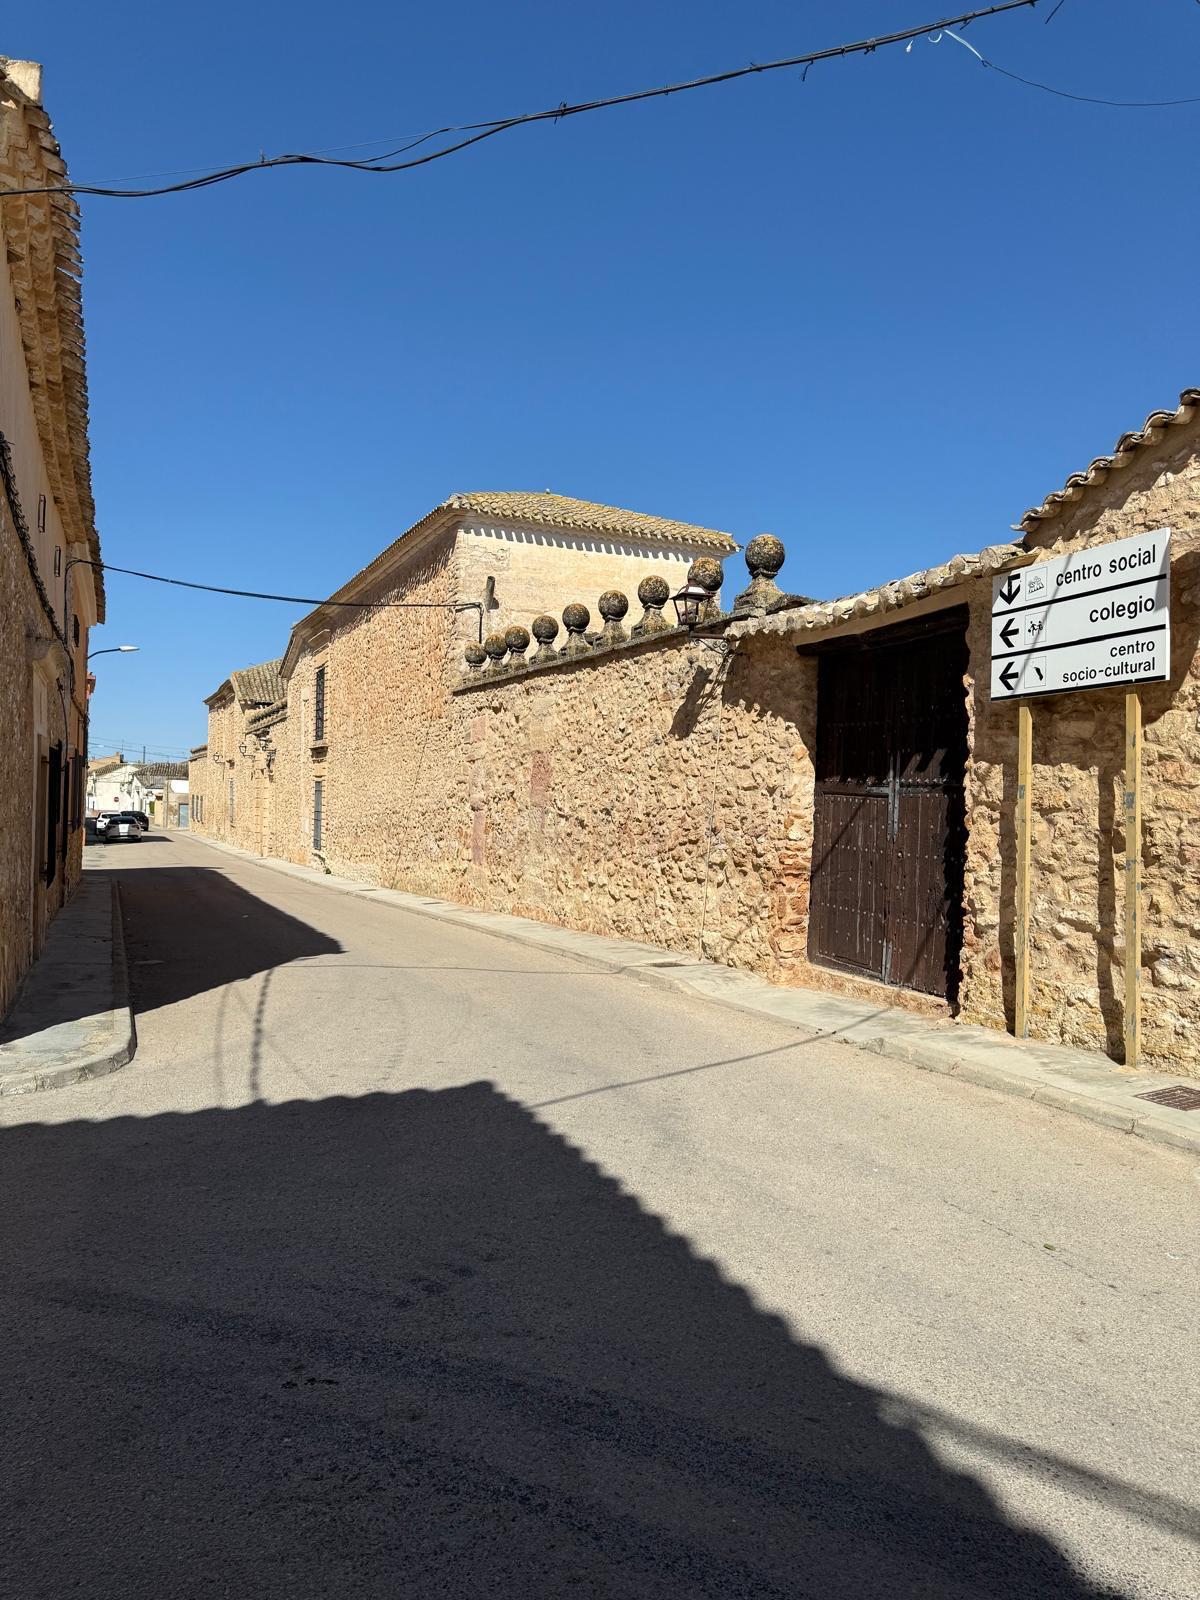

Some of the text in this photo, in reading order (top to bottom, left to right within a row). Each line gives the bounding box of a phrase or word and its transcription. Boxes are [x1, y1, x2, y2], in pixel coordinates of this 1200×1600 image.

[1056, 544, 1156, 587] centro social
[1089, 595, 1155, 623] colegio
[1110, 640, 1155, 658] centro
[1062, 657, 1155, 683] socio-cultural
